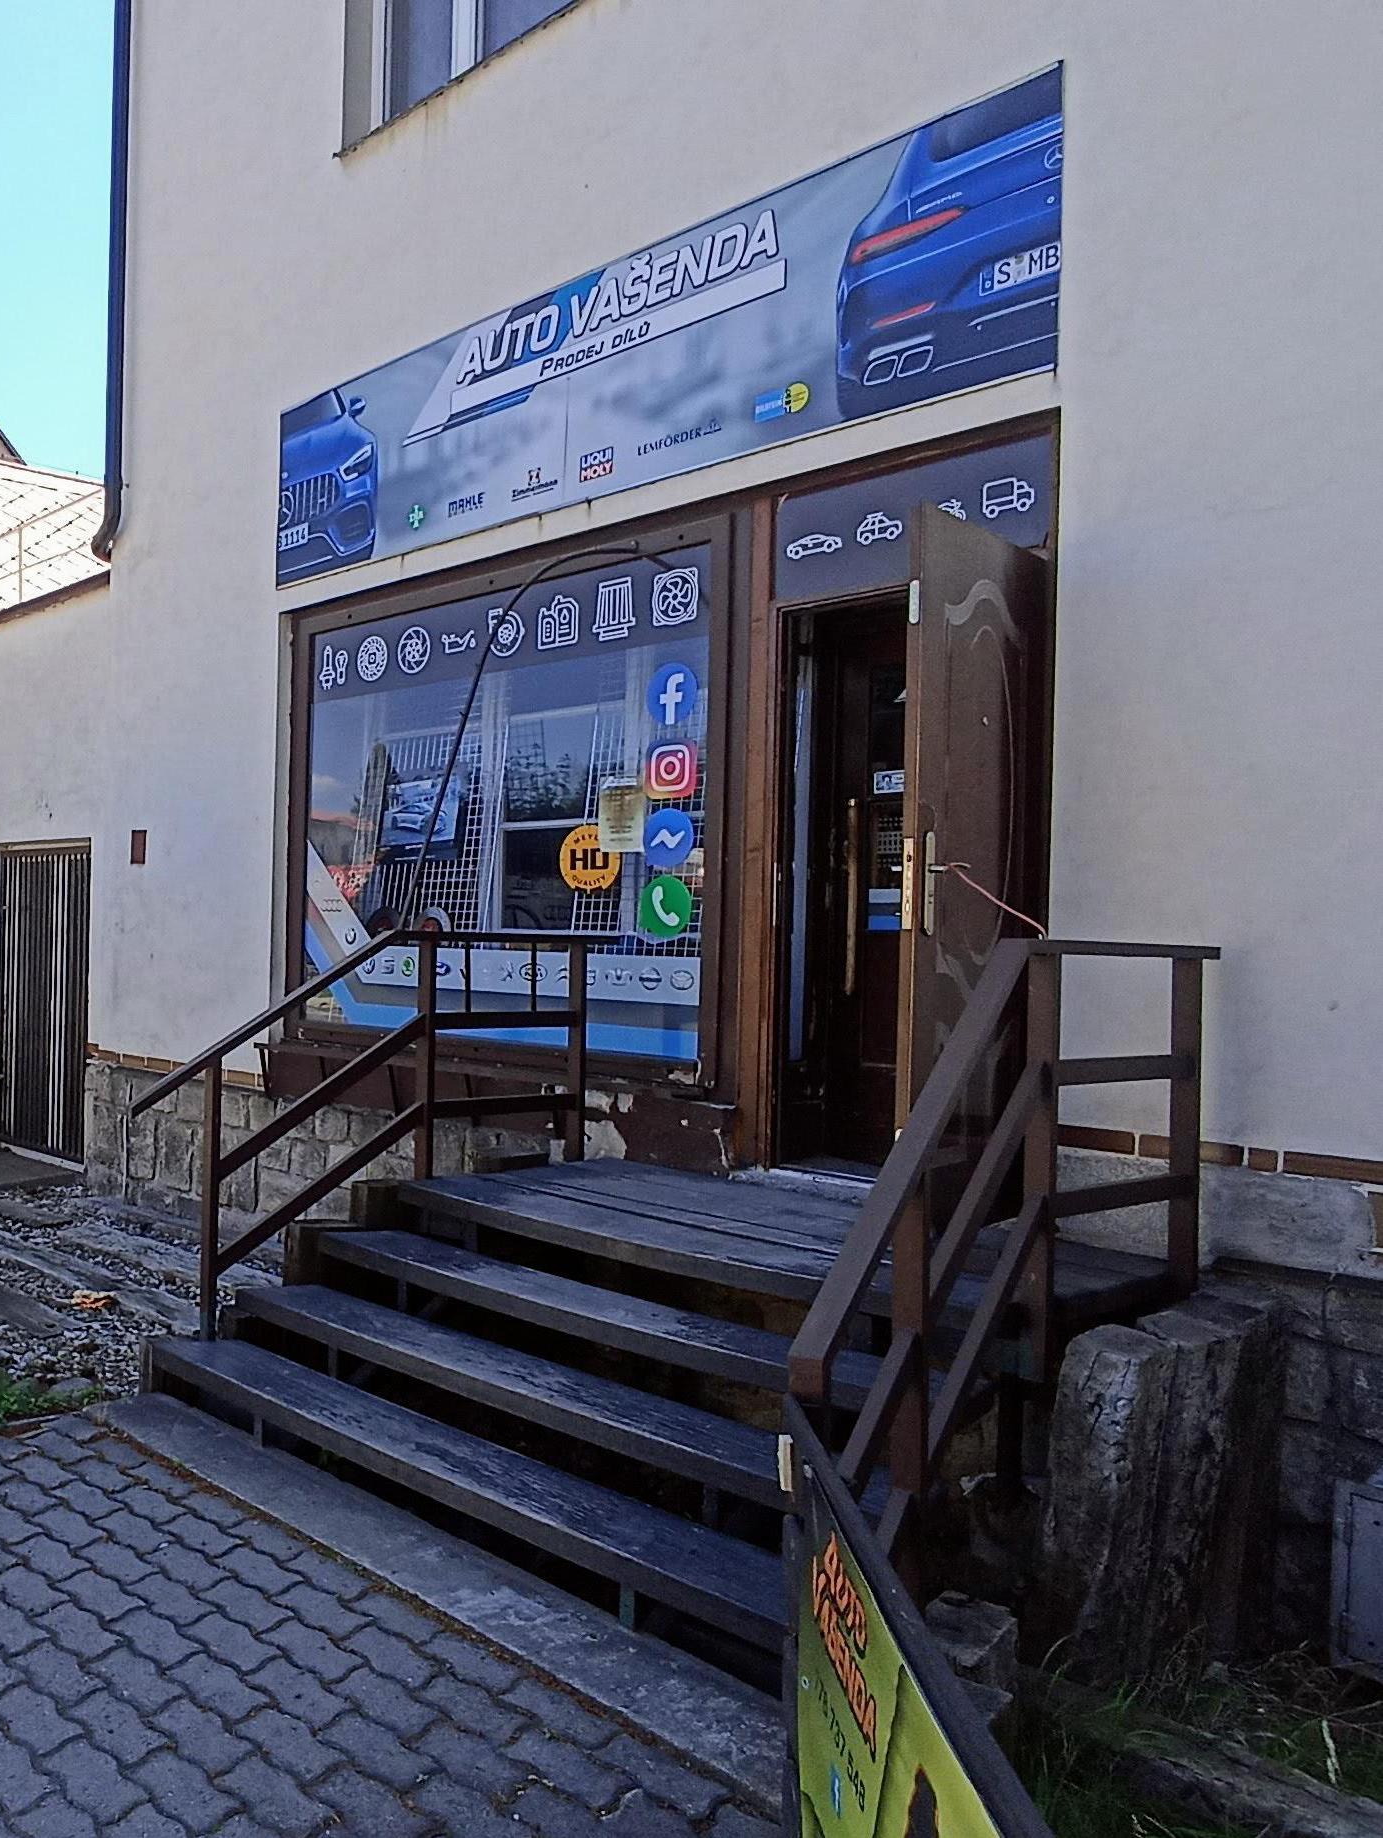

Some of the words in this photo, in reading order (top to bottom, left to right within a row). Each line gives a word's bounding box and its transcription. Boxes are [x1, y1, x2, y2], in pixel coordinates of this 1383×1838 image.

[1028, 244, 1060, 275] MB
[456, 303, 562, 385] AUTO
[569, 208, 779, 338] VAŠENDA
[539, 341, 605, 377] PRODEJ
[637, 426, 702, 456] LEMFÖRDER
[581, 447, 613, 468] LIQUI
[581, 461, 613, 482] MOLY
[448, 491, 485, 513] MAHLE
[570, 847, 610, 871] HD
[571, 874, 607, 887] QUALITY
[847, 1749, 866, 1813] 548
